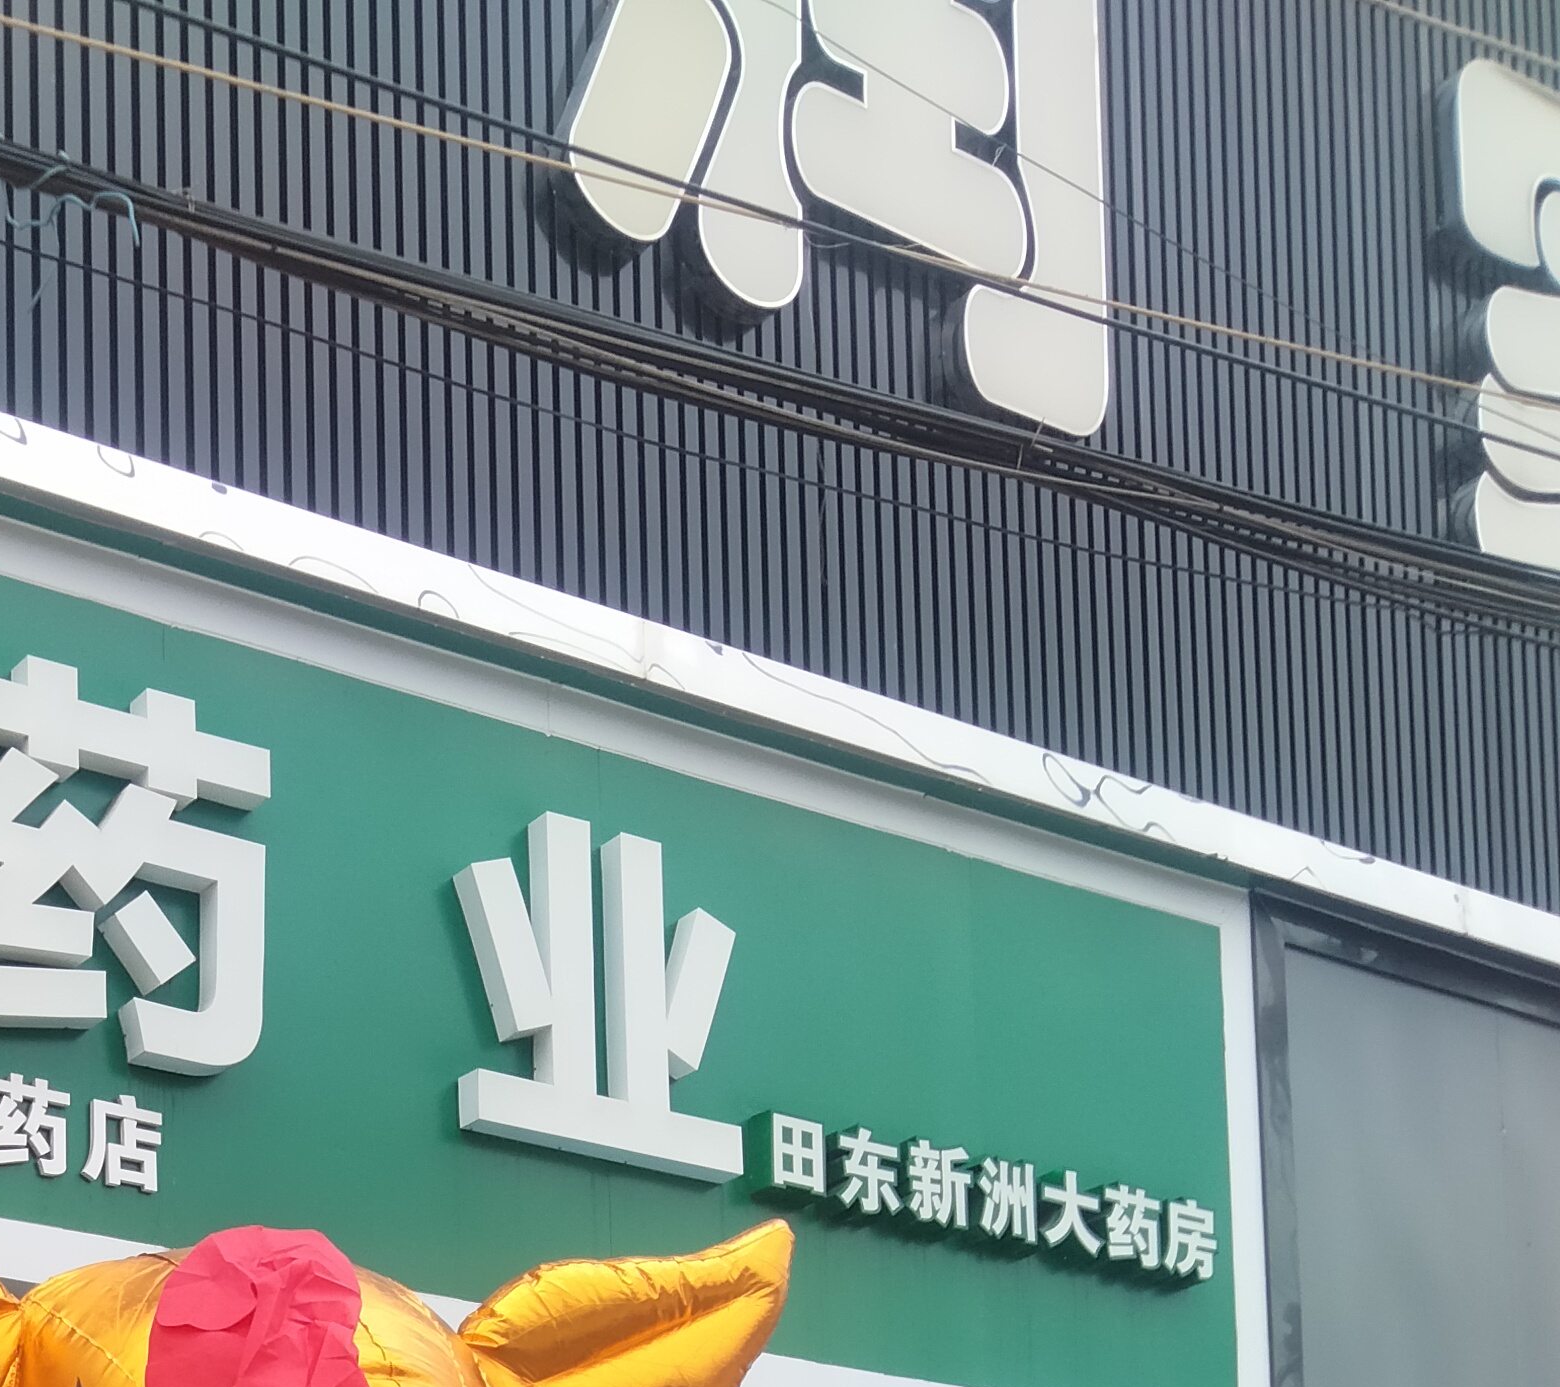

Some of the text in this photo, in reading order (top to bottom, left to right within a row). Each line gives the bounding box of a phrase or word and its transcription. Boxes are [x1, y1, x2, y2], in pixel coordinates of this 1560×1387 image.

[772, 1113, 1217, 1280] 田东新洲大药房
